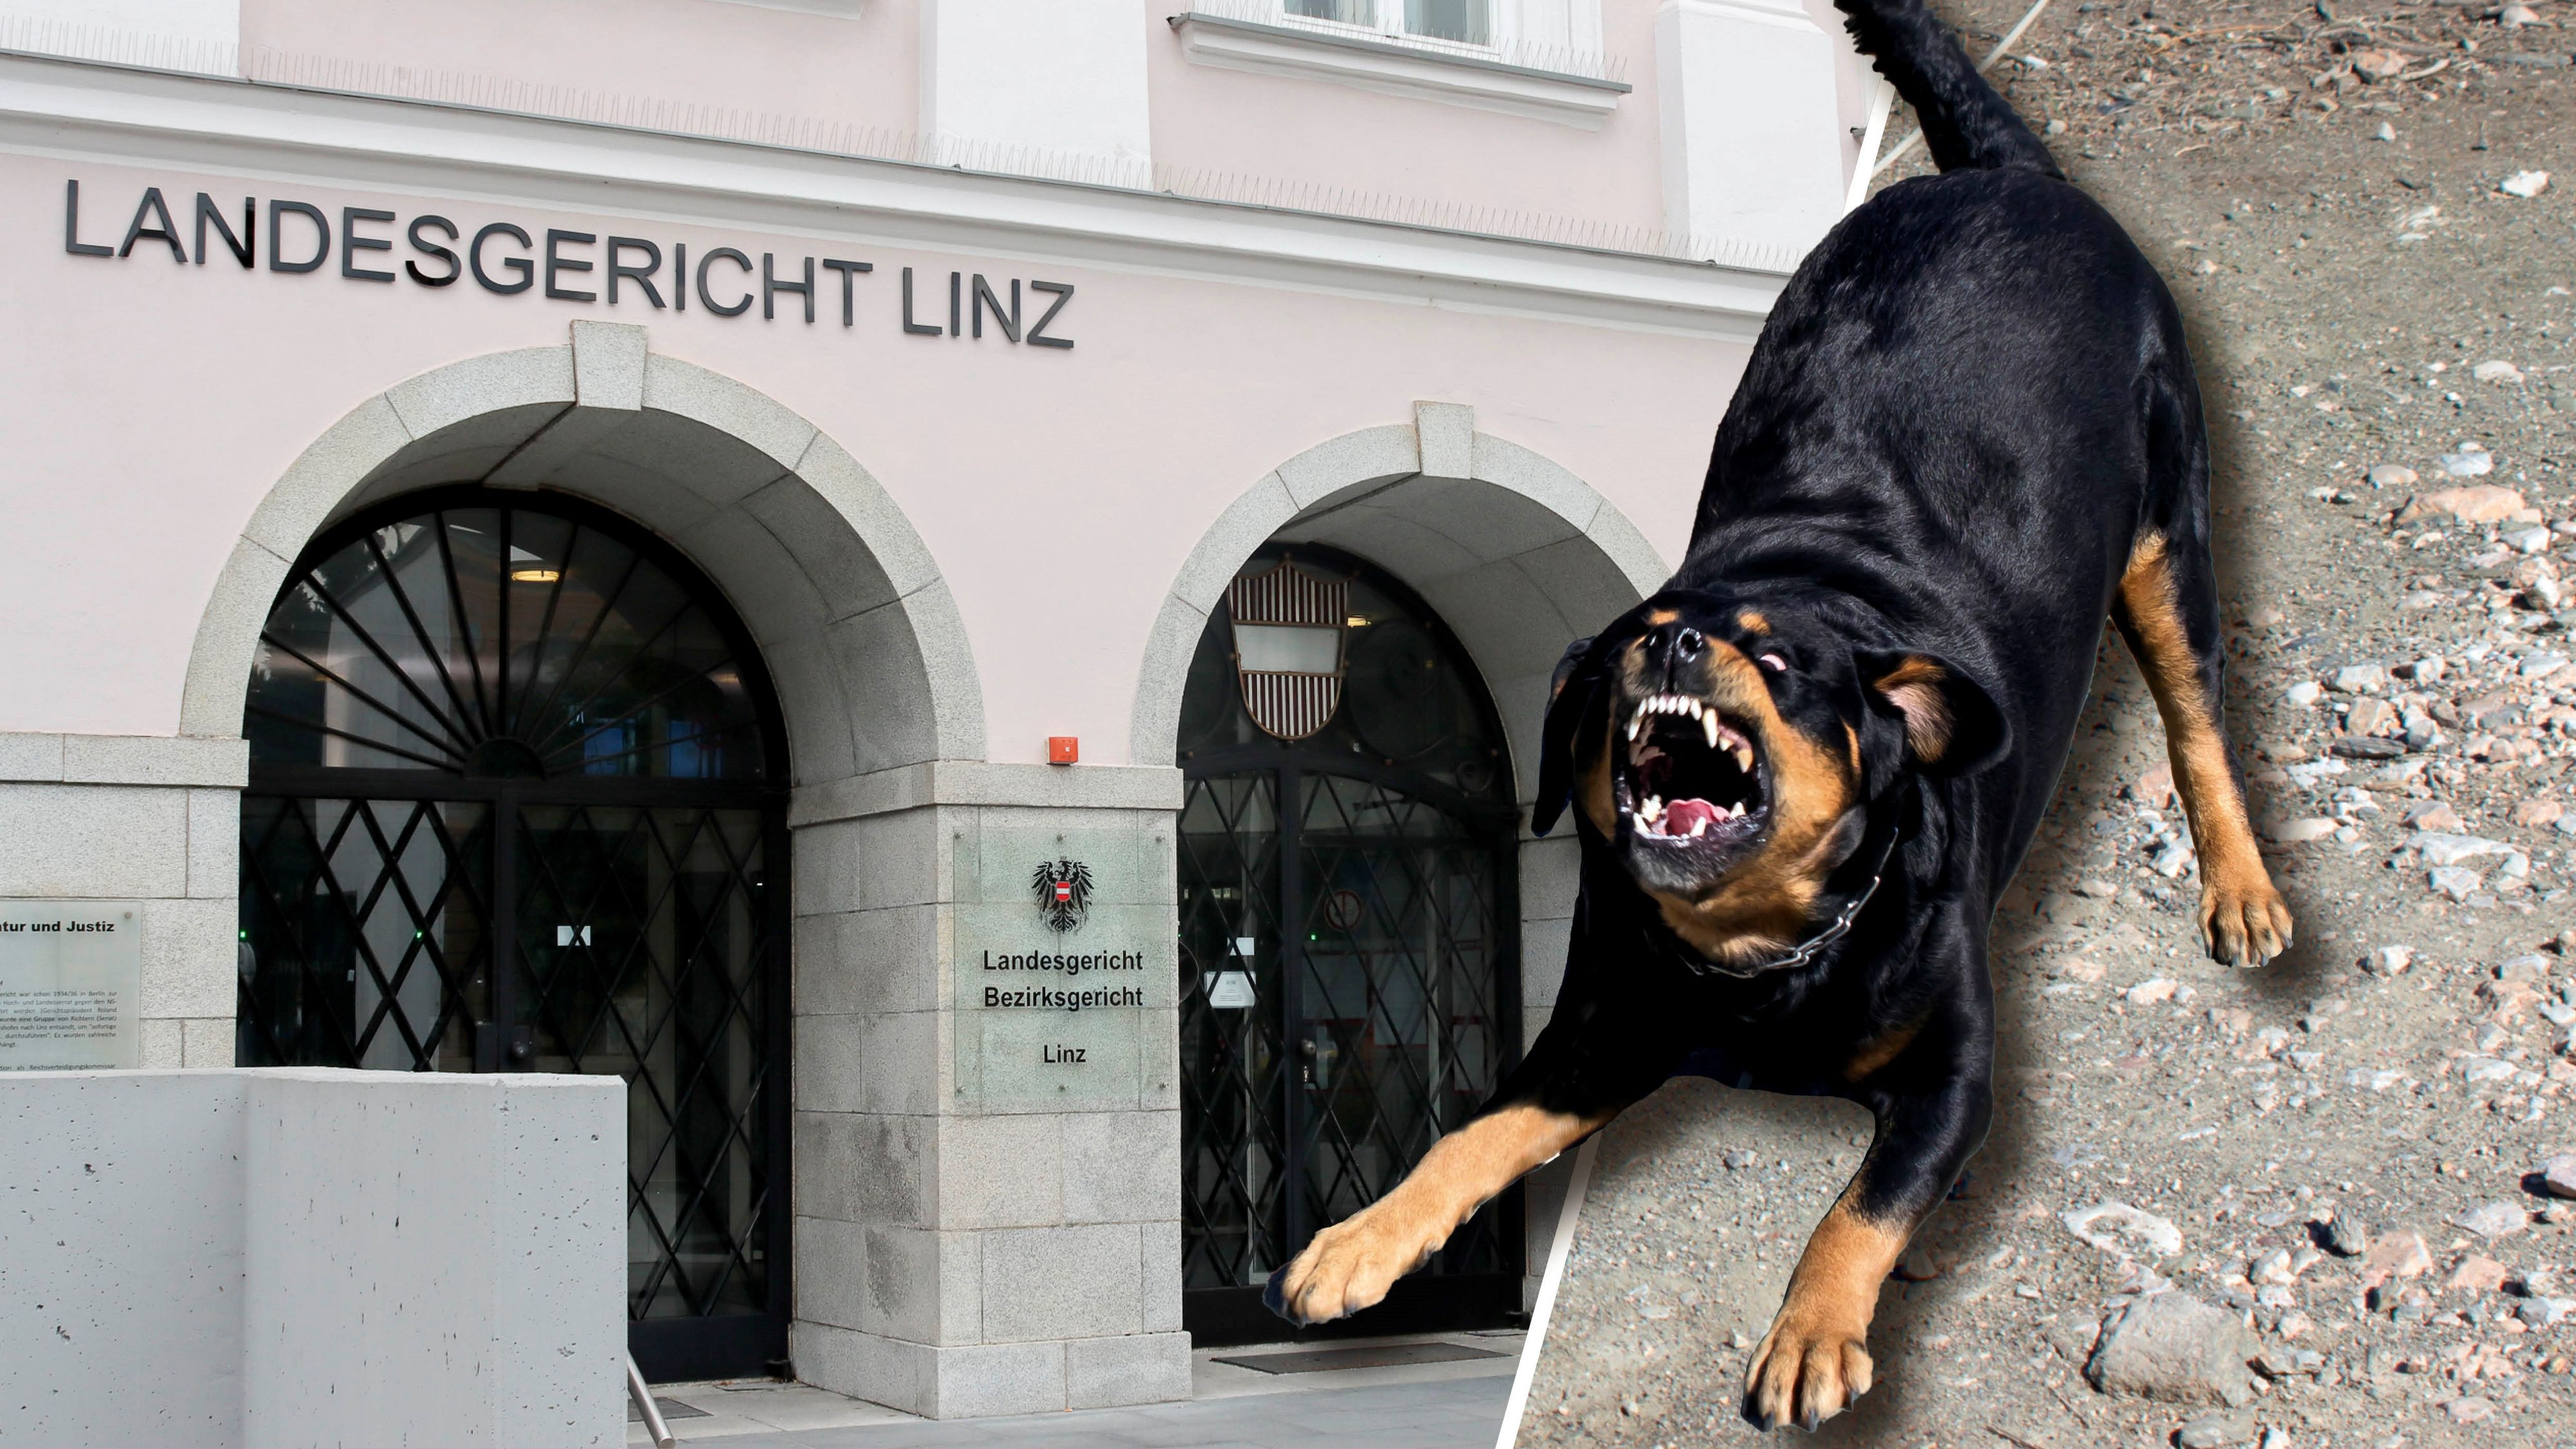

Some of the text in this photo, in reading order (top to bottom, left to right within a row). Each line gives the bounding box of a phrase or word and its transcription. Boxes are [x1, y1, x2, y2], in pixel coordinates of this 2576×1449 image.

[66, 179, 1074, 350] LANDESGERICHT LINZ
[0, 921, 115, 932] tur und Justiz
[983, 950, 1143, 976] Landesgericht
[985, 986, 1143, 1012] Bezirksgericht
[1044, 1044, 1086, 1063] Linz
